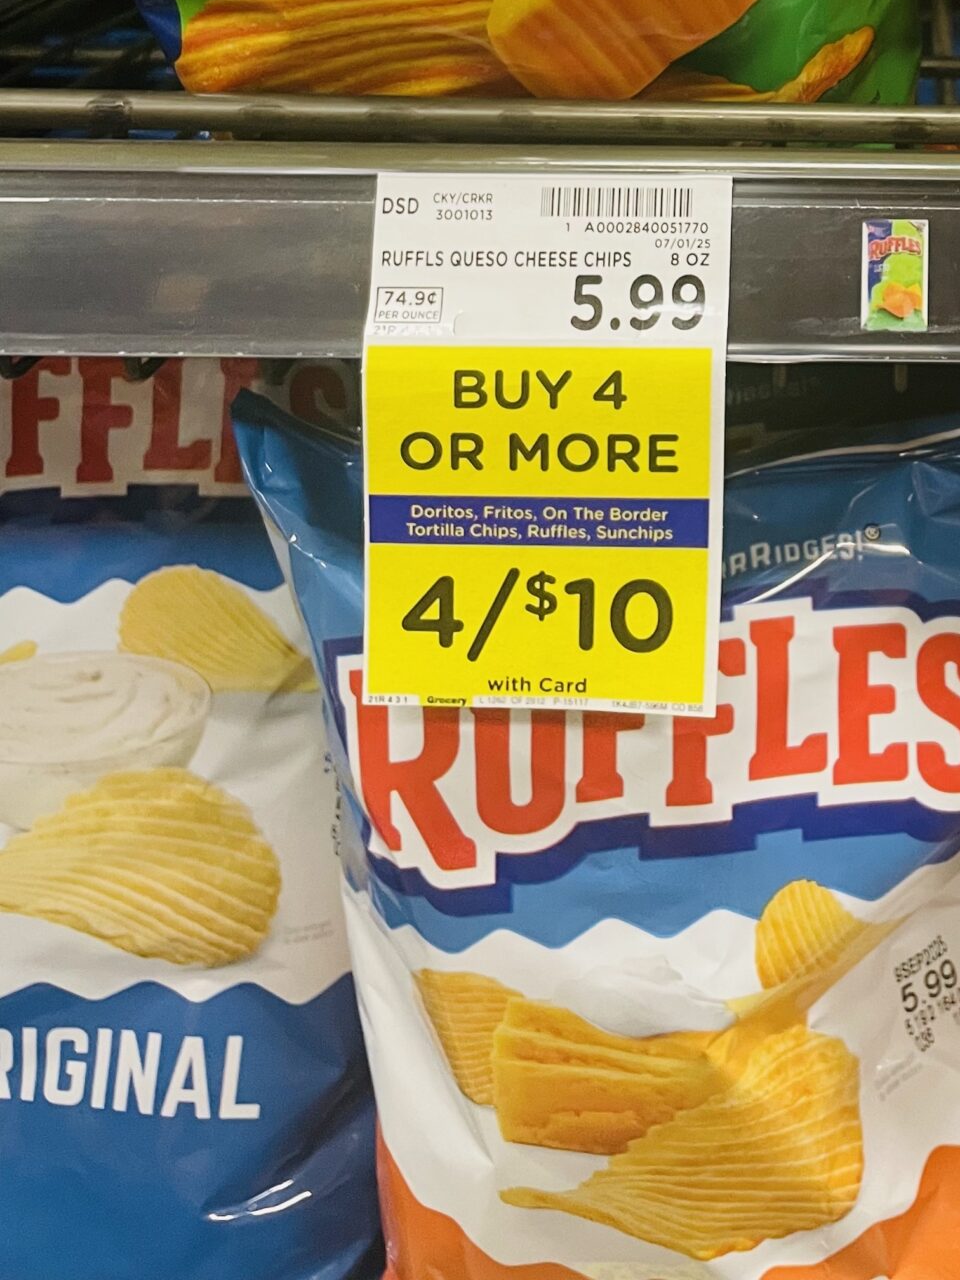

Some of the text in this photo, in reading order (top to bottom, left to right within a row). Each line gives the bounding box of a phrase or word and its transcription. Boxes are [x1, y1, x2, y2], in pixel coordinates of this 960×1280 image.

[383, 198, 420, 215] DSD
[433, 192, 493, 206] CKY/CRKR
[436, 209, 493, 221] 3001013
[585, 222, 709, 235] A0002840051770
[654, 238, 711, 250] 07/01/25
[381, 251, 632, 268] RUFFLS QUESO CHEESE CHIPS
[671, 253, 710, 266] 8 OZ
[384, 290, 437, 306] 74.9¢
[570, 274, 706, 331] 5.99
[378, 310, 439, 320] PER OUNCE
[453, 369, 627, 410] BUY 4
[400, 431, 679, 473] OR MORE
[411, 504, 669, 522] Doritos, Fritos, On The Border
[406, 522, 673, 542] Tortilla Chips, Ruffles, Sunchips
[402, 567, 673, 662] 4/$10
[488, 677, 587, 694] with Card
[427, 695, 467, 706] Grocery
[901, 959, 957, 1012] 5.99
